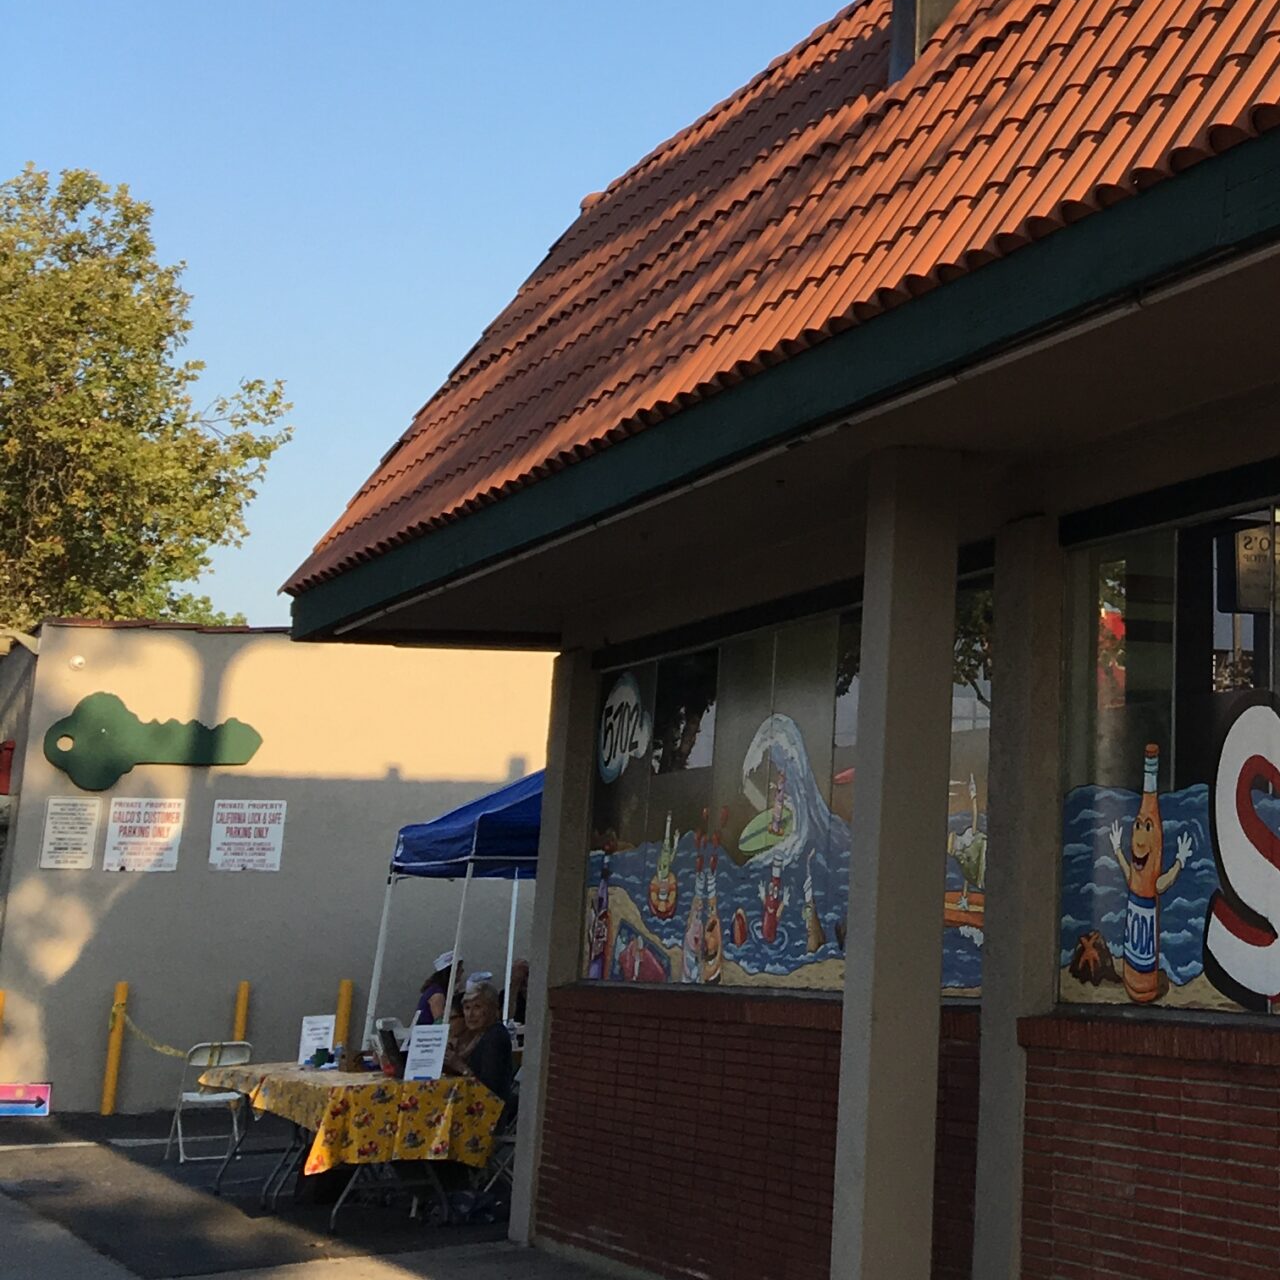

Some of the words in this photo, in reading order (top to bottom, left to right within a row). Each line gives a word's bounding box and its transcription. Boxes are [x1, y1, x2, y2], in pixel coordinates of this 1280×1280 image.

[603, 701, 641, 767] 5702
[112, 811, 142, 824] GALCO'S
[118, 825, 150, 838] PARKING
[152, 826, 171, 838] ONLY
[225, 826, 252, 838] PARKING
[253, 827, 269, 838] ONLY
[1125, 908, 1154, 955] SODA
